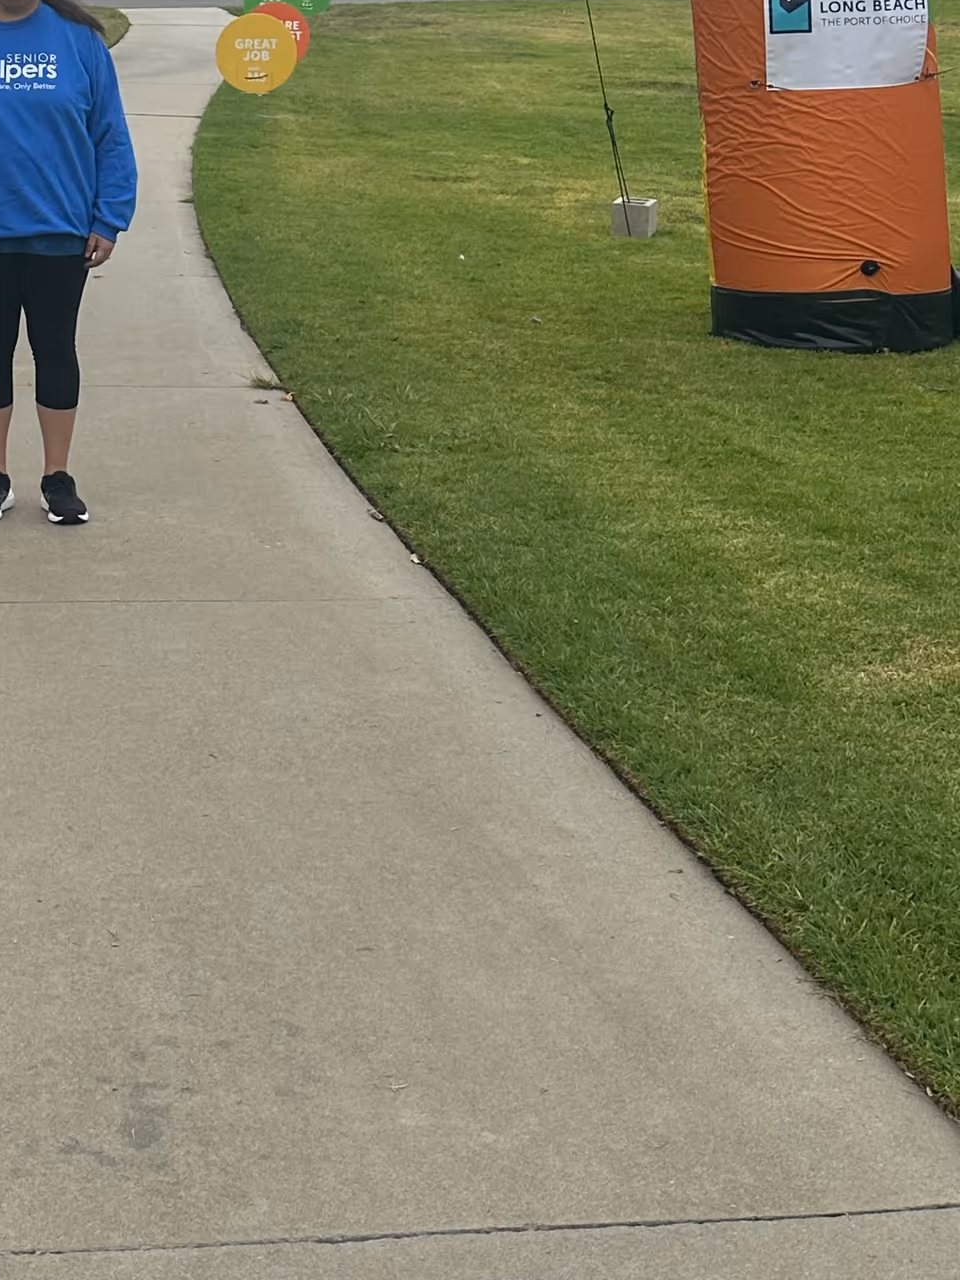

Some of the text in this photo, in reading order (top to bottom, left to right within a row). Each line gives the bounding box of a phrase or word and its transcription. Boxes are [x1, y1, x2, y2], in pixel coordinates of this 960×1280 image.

[820, 0, 867, 14] LONG
[281, 20, 300, 30] RE
[820, 14, 927, 27] THE PORT OF CHOICE
[235, 38, 279, 50] GREAT
[6, 53, 57, 64] SENIOR
[243, 50, 270, 61] JOB
[13, 82, 32, 91] Only
